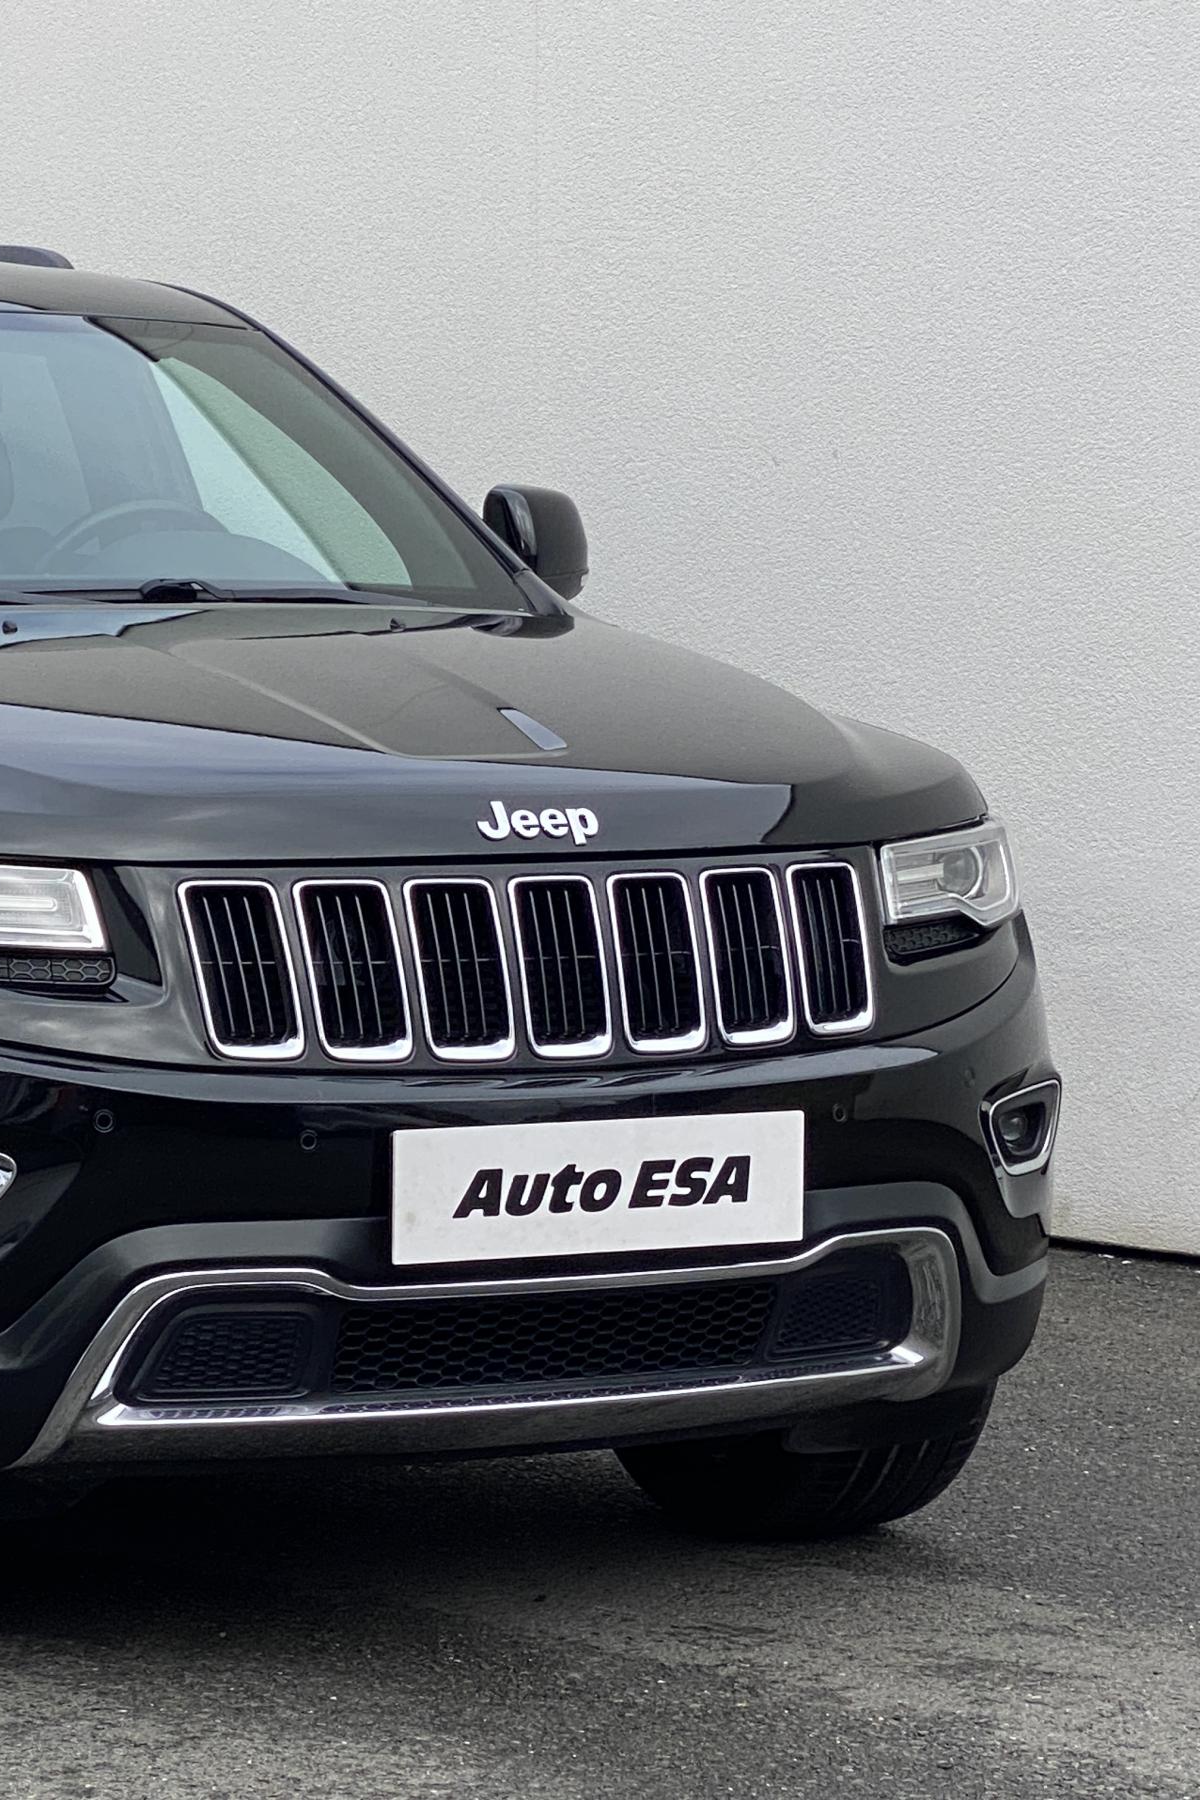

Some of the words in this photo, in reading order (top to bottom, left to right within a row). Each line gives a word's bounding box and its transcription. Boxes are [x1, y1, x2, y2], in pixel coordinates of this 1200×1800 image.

[477, 800, 599, 846] Jeep
[452, 1164, 623, 1219] Auto
[628, 1155, 751, 1209] ESA
